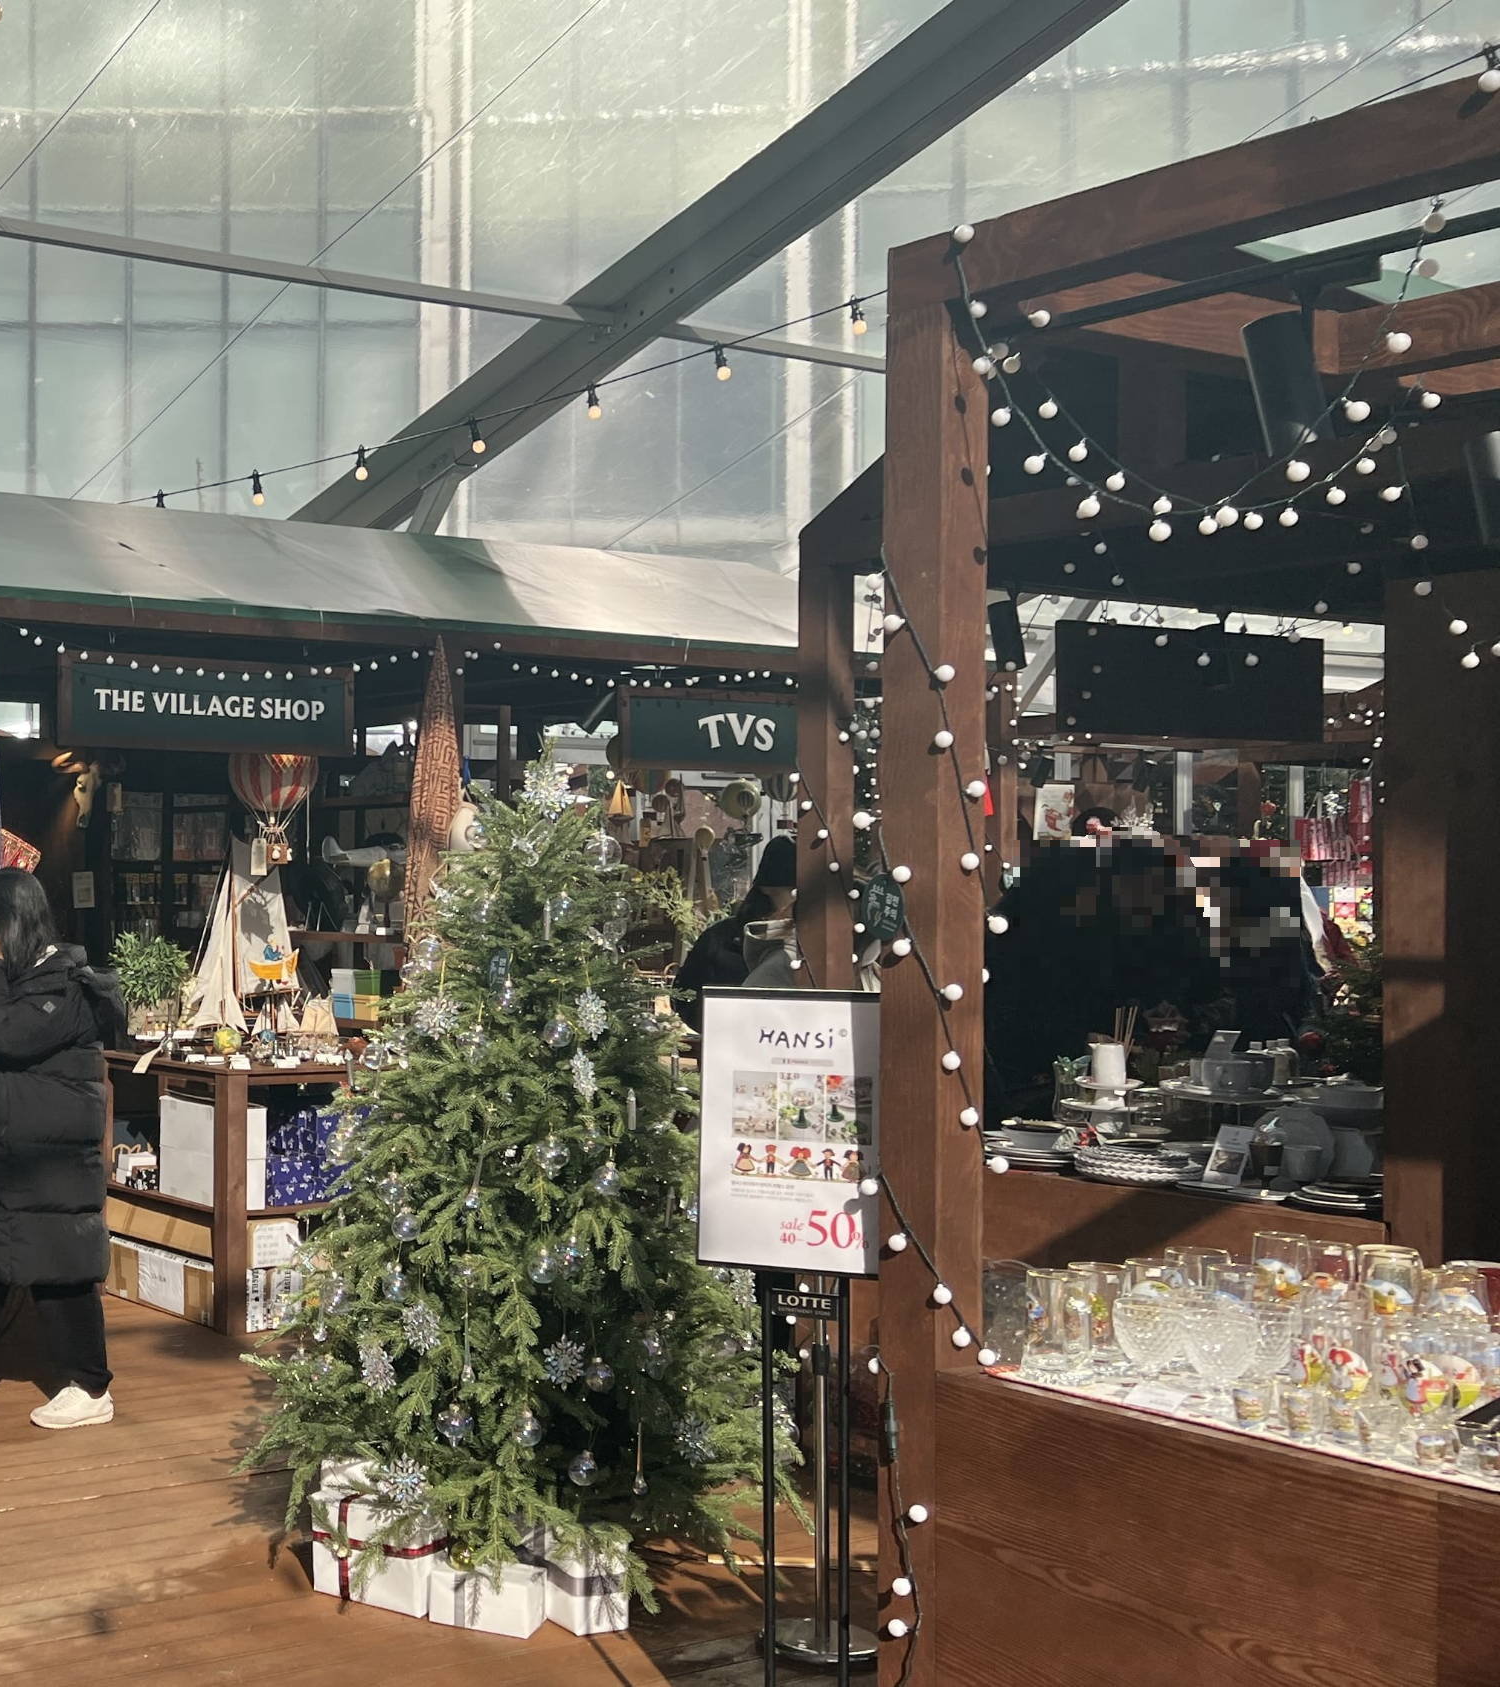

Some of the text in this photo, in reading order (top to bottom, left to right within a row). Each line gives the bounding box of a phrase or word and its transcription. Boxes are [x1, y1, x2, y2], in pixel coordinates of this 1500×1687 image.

[94, 688, 325, 722] THE VILLAGE SHOP
[697, 712, 776, 752] TVS
[780, 1217, 804, 1231] sale
[777, 1294, 831, 1310] LOTTE
